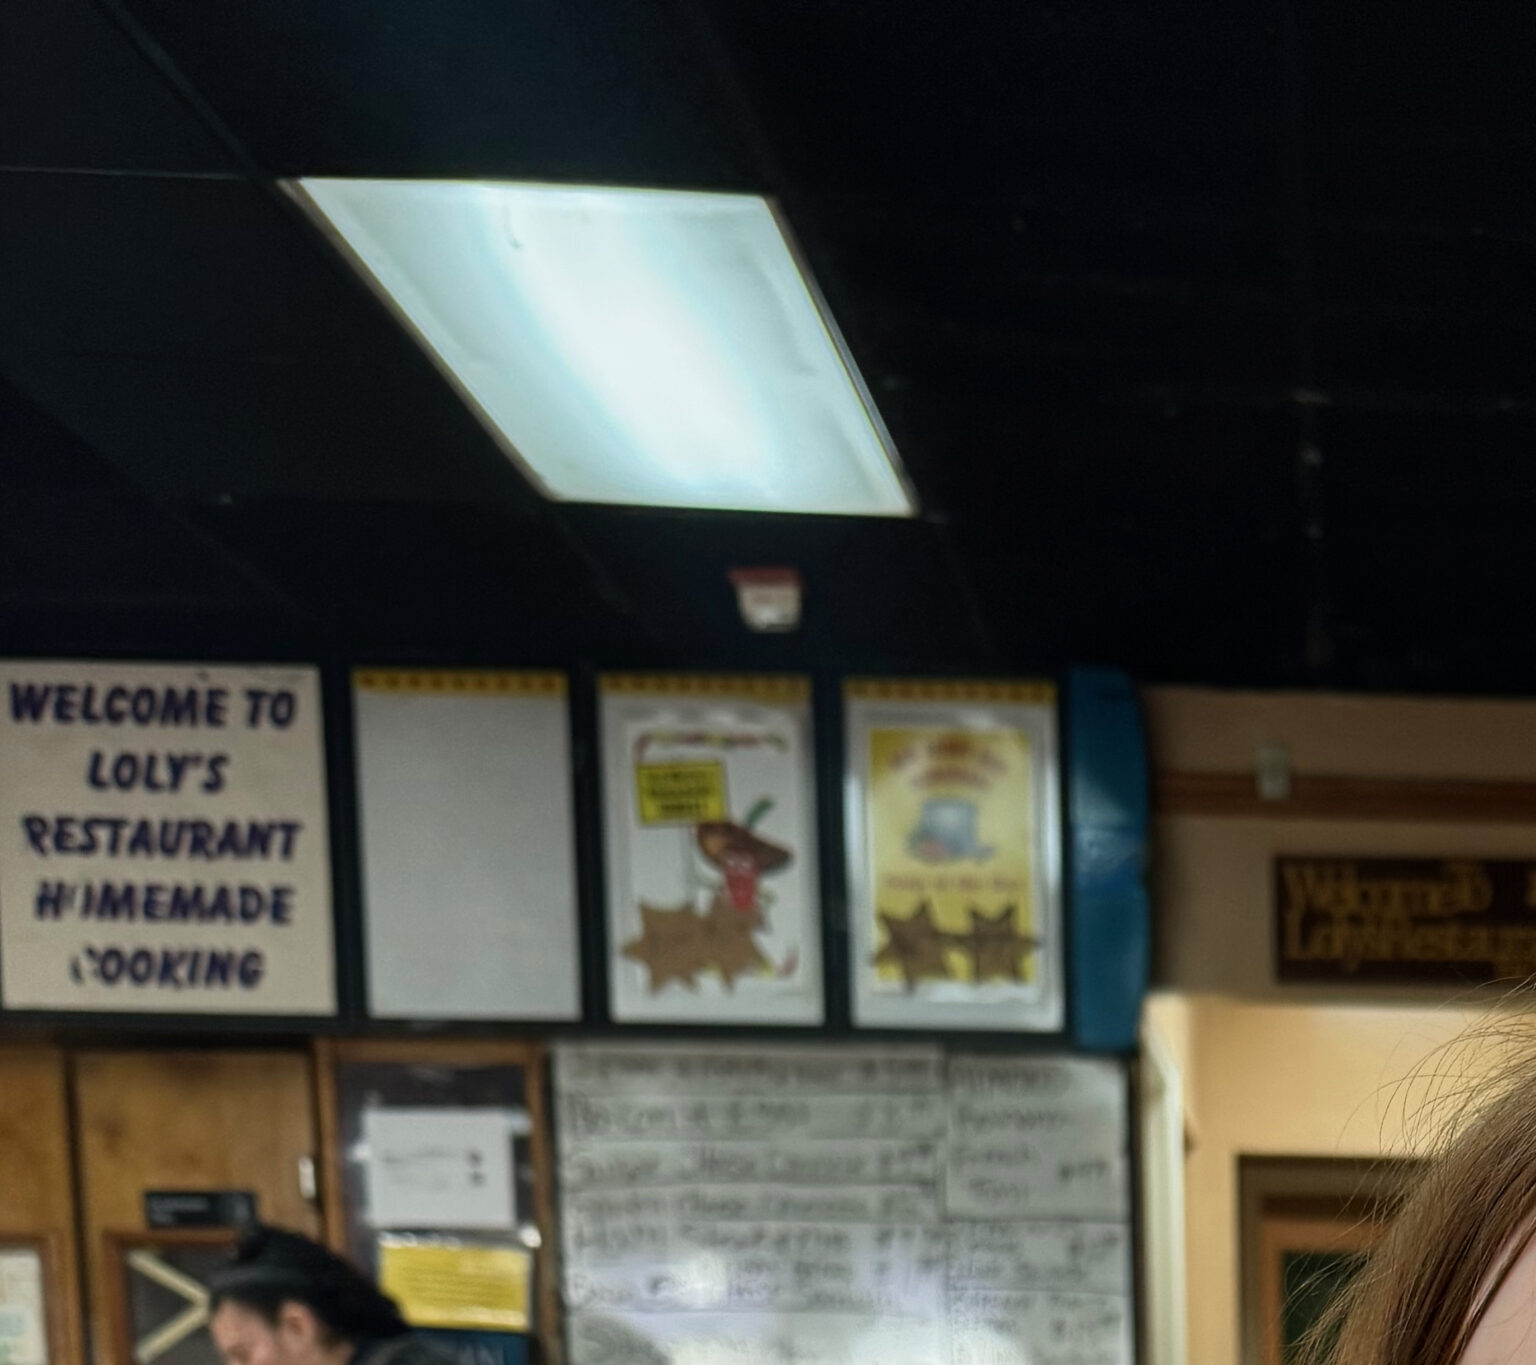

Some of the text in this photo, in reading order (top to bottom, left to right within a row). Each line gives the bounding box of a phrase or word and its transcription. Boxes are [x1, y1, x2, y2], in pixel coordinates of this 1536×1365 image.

[9, 682, 297, 729] WELCOME TO
[87, 750, 230, 794] LOLY'S
[22, 815, 303, 860] RESTAURANT
